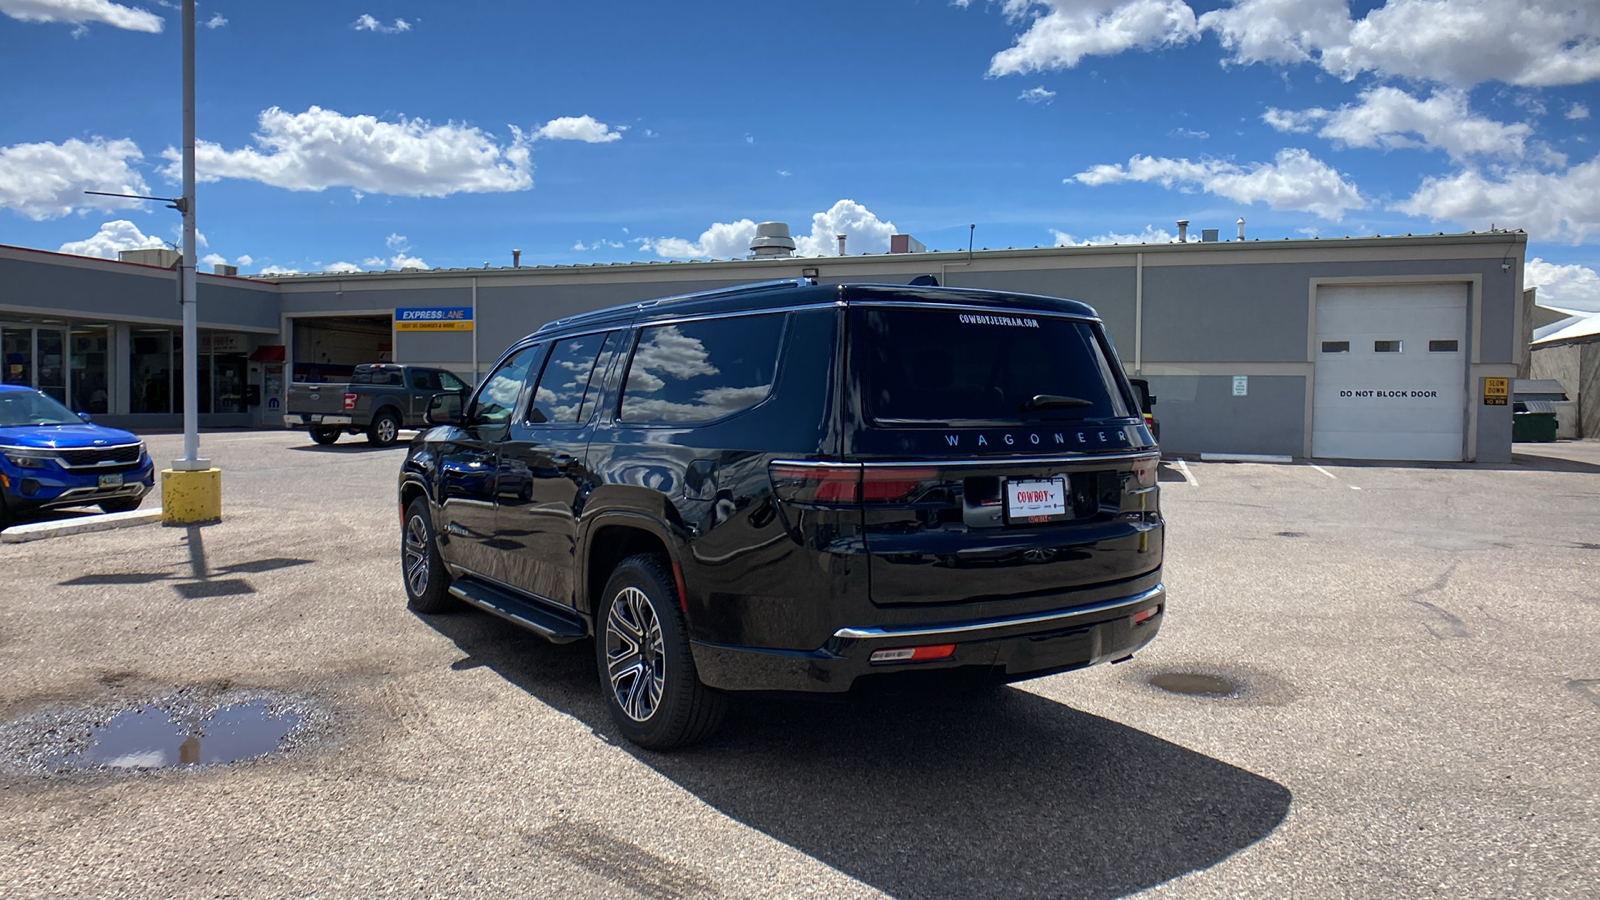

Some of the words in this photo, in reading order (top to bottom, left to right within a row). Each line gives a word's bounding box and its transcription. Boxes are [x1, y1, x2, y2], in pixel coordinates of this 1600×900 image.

[959, 314, 1040, 328] COWBOYJEEPRAM.COM
[1340, 390, 1353, 398] DO
[1355, 390, 1374, 398] NOT
[1376, 390, 1408, 398] BLOCK
[1410, 390, 1437, 398] DOOR
[944, 430, 1126, 447] WAGONEER
[1017, 490, 1049, 503] COWBOY
